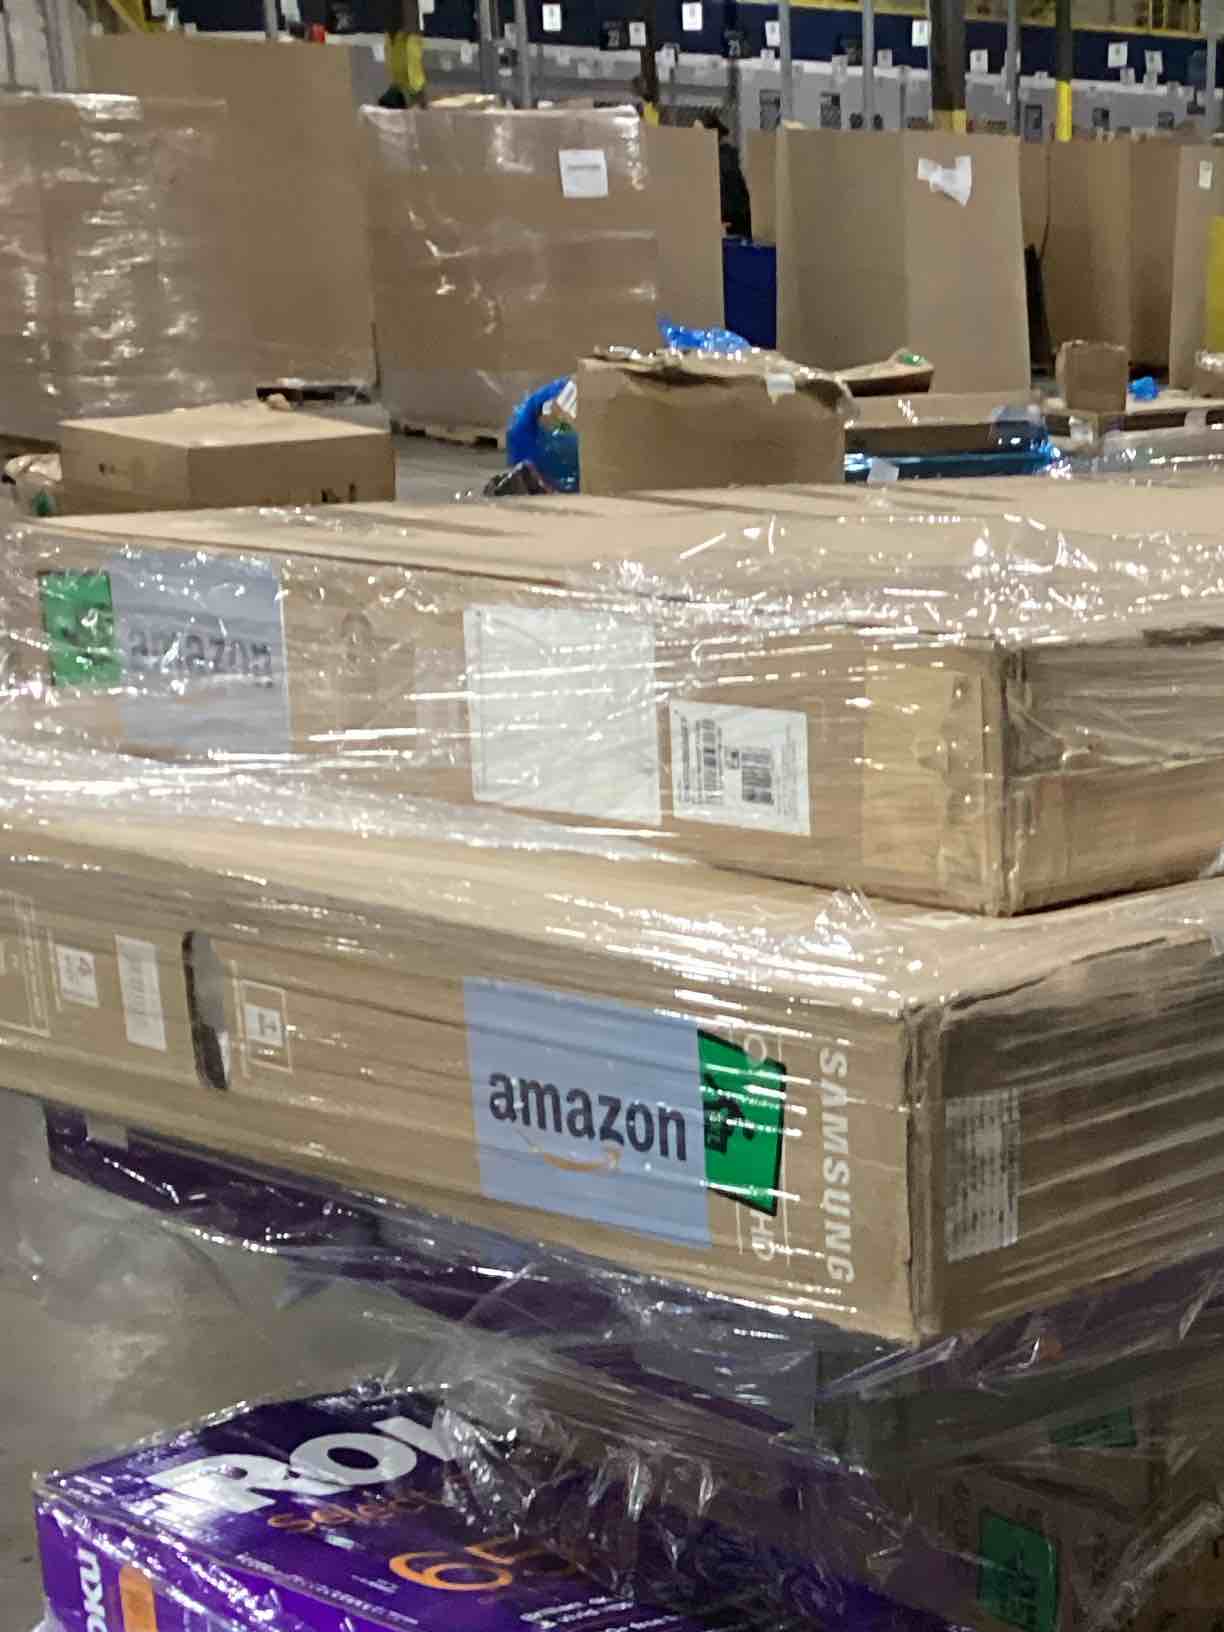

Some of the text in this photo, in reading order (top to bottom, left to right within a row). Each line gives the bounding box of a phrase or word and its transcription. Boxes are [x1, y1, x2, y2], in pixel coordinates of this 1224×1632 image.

[489, 1071, 688, 1162] amazon
[820, 1048, 856, 1284] SAMSUNG
[145, 1404, 456, 1515] RO
